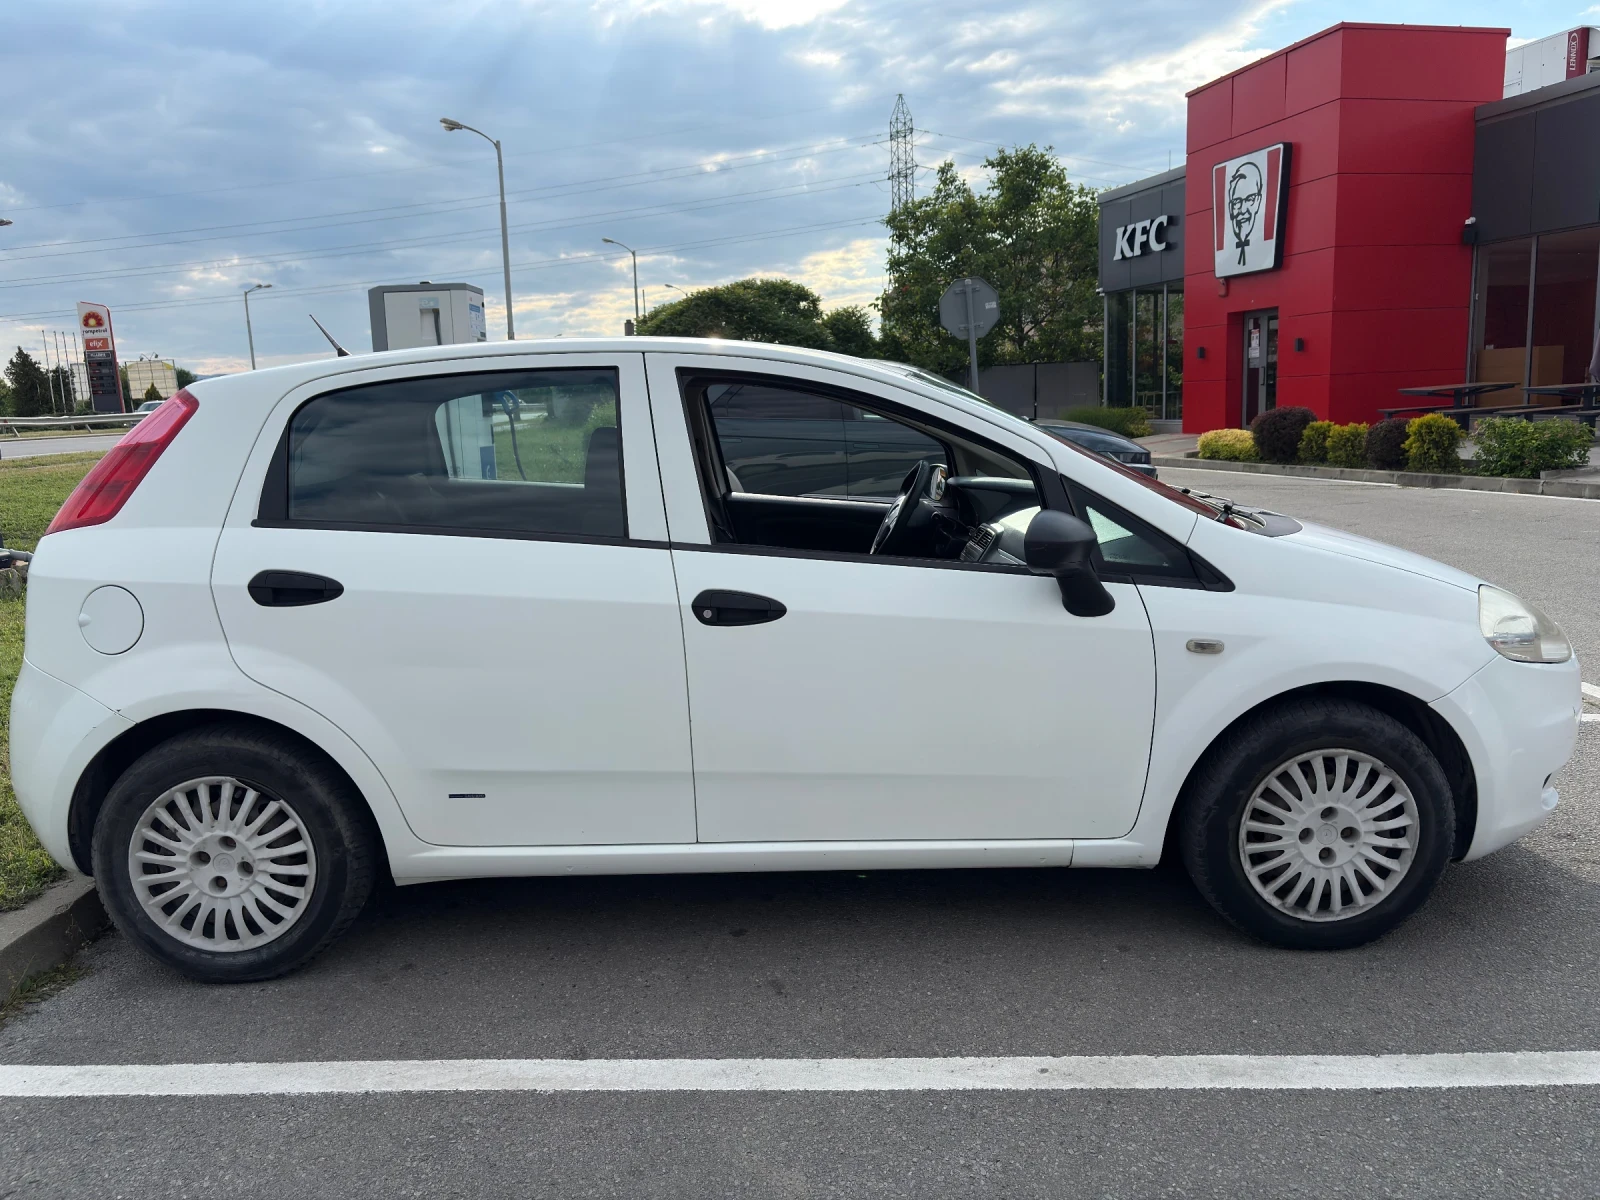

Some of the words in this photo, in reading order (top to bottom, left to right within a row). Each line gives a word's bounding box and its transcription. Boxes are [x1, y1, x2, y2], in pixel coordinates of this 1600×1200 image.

[1569, 40, 1577, 71] LENNOX
[1113, 214, 1168, 261] KFC
[82, 328, 108, 336] rompetrol
